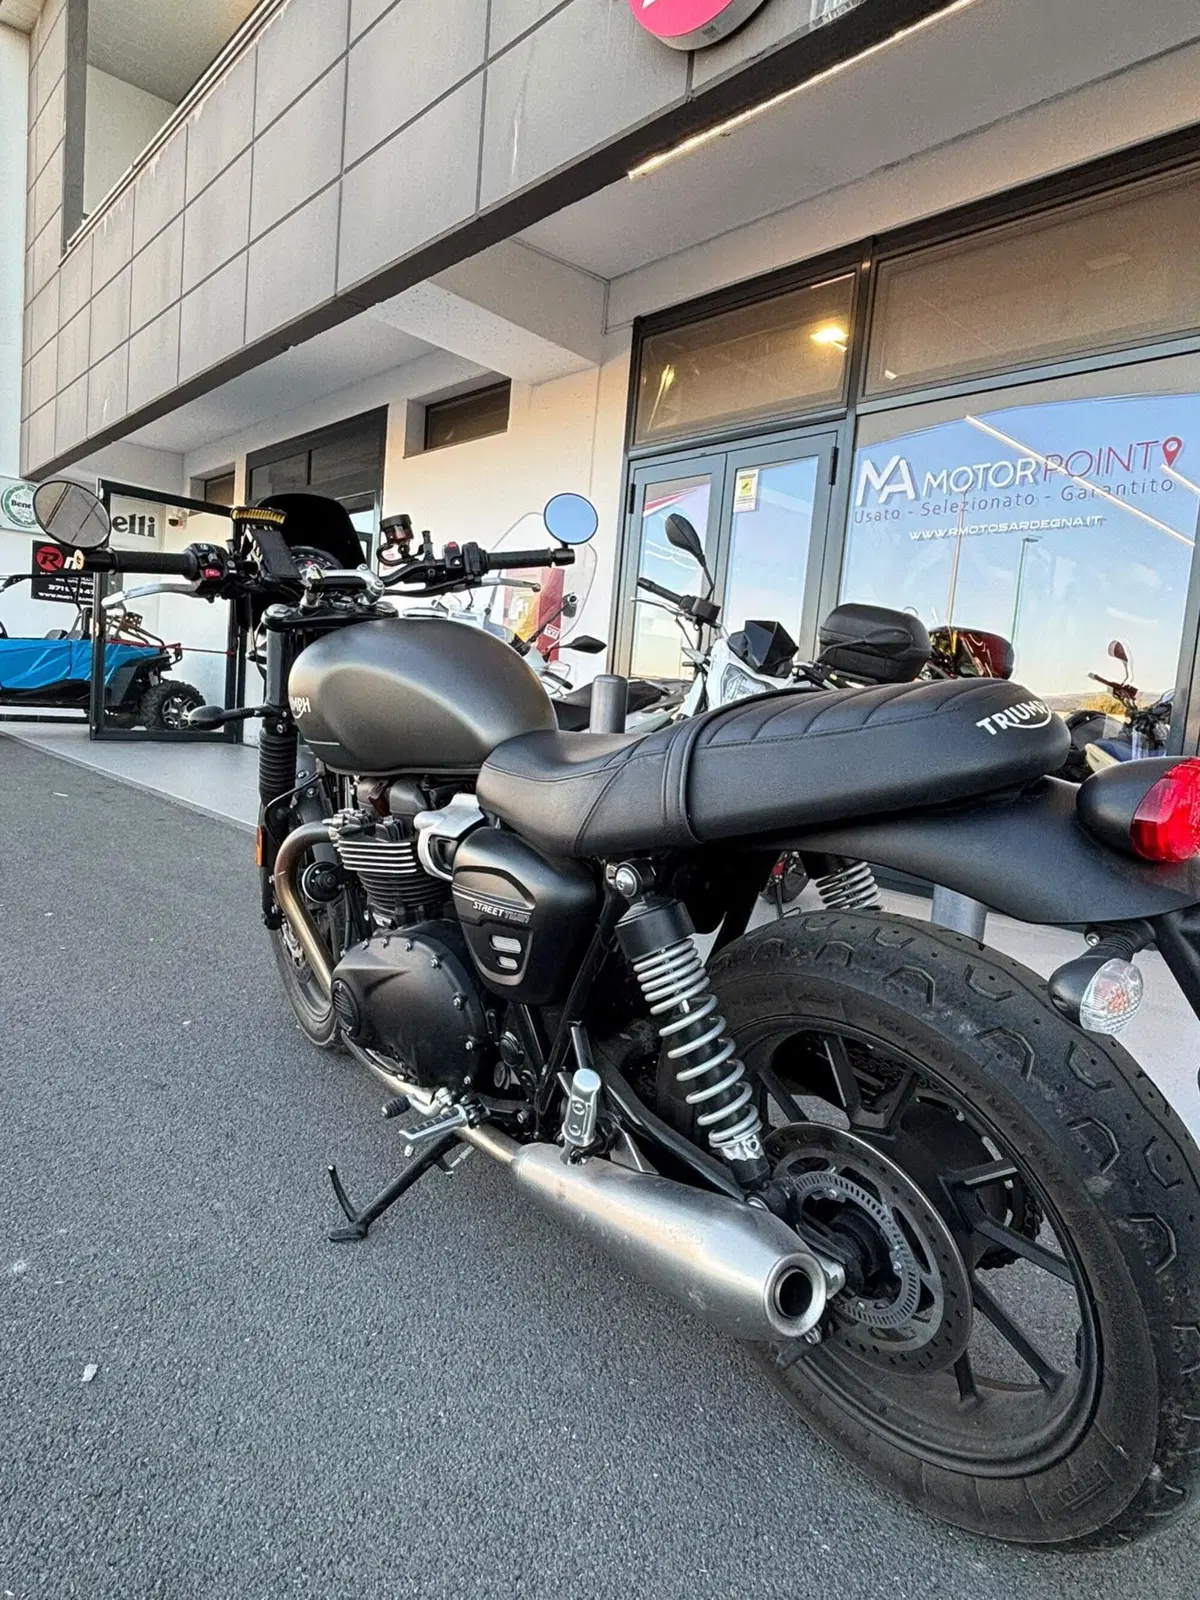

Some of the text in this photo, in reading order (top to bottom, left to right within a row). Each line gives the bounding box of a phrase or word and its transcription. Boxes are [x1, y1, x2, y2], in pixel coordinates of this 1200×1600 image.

[855, 509, 901, 524] Usato
[921, 493, 1035, 517] Selezionato
[1061, 478, 1174, 501] Garantito
[473, 900, 505, 917] STREET
